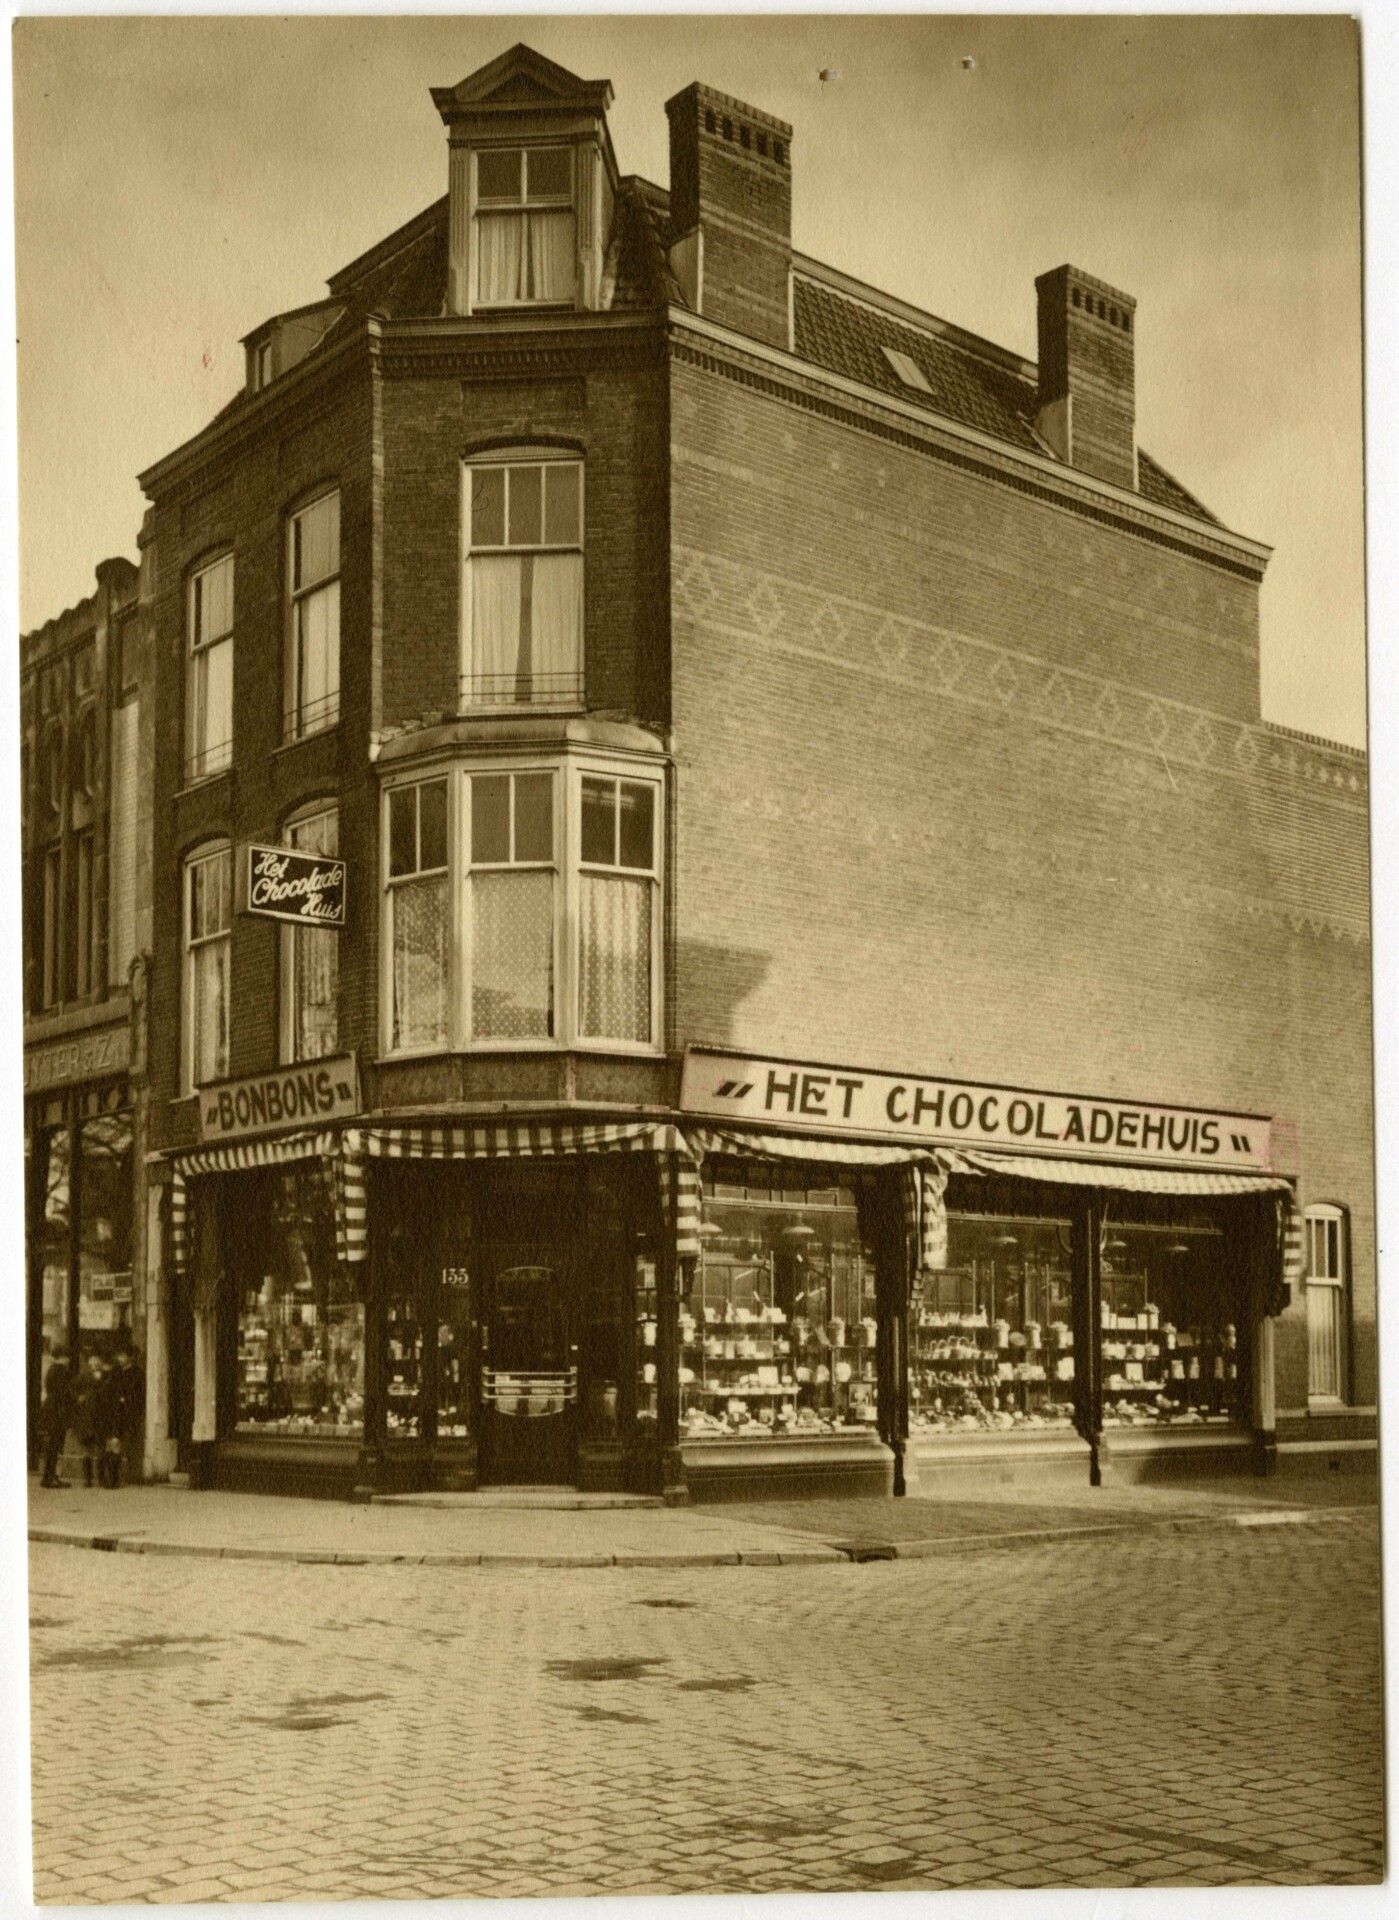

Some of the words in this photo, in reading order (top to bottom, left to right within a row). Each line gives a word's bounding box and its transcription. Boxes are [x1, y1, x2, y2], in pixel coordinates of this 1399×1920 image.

[254, 852, 290, 879] Het
[252, 864, 342, 905] Chocolade
[300, 892, 342, 919] Huis
